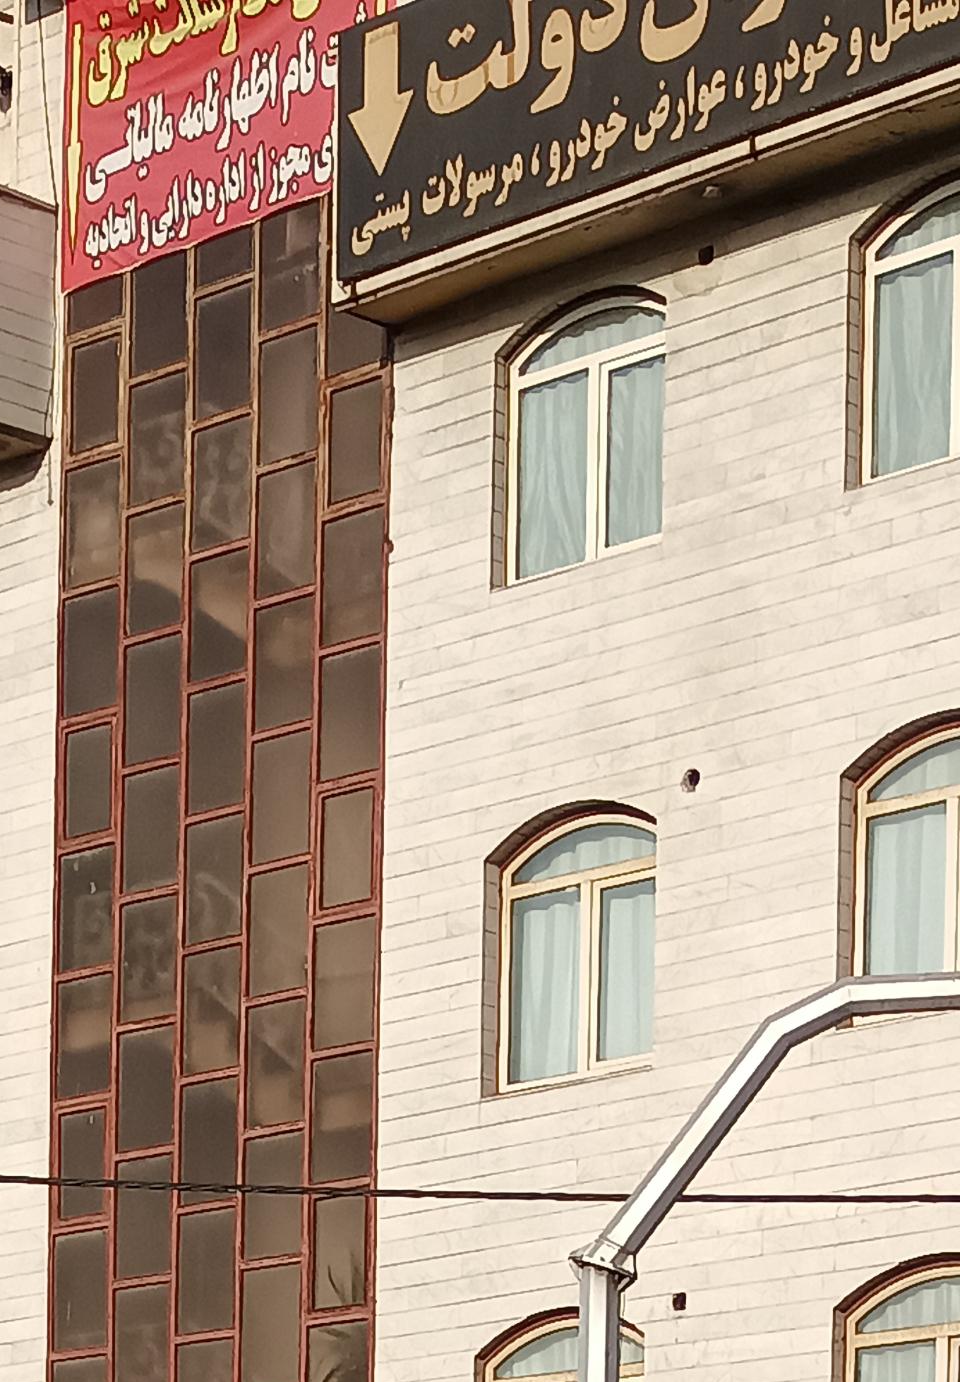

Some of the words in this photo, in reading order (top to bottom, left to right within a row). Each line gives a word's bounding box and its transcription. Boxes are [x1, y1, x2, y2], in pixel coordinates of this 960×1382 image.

[280, 27, 317, 126] نام
[425, 0, 630, 116] دولت
[730, 14, 840, 112] خودرو
[845, 26, 864, 77] و
[84, 91, 175, 203] مالیاتی
[545, 95, 628, 188] خودرو
[633, 69, 728, 152] عوارض
[152, 169, 205, 249] دارایی
[204, 150, 247, 226] اداره
[248, 140, 266, 213] از
[267, 144, 312, 206] مجوز
[421, 152, 524, 218] مرسولات
[350, 189, 411, 257] پستی
